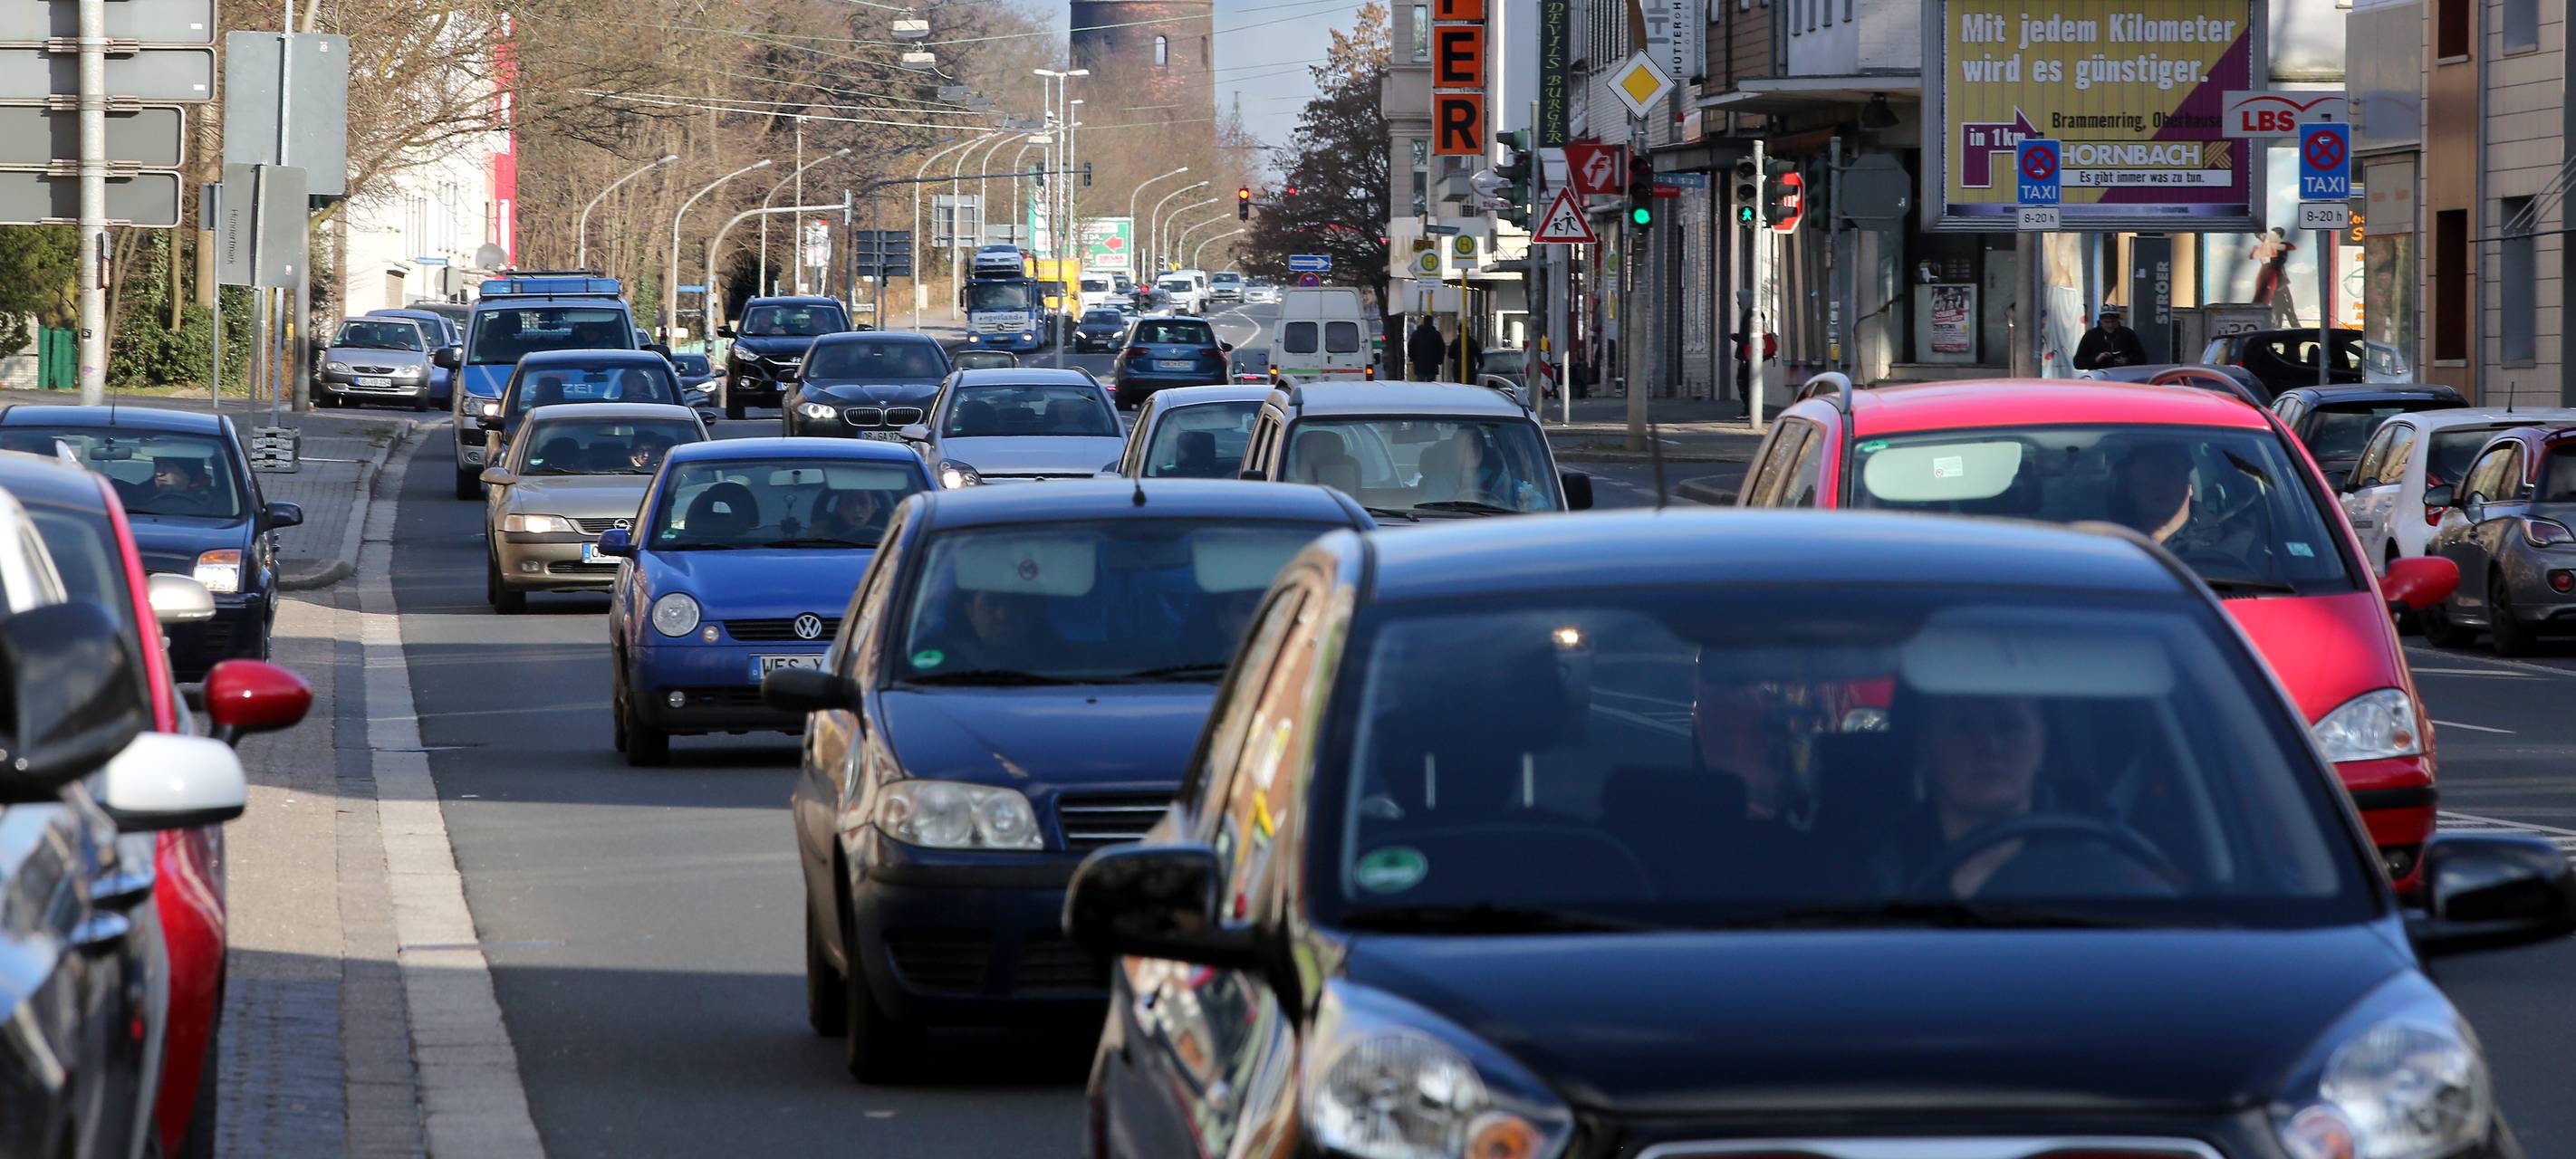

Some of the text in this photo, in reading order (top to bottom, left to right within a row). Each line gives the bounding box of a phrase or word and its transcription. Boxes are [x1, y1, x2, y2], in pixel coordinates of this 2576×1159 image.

[1962, 13, 2236, 49] Mit jedem Kilometer
[1545, 2, 1564, 143] DEVILS BURGER
[1962, 53, 2209, 90] wird es günstiger.
[2052, 112, 2147, 132] Brammenring,
[2242, 110, 2295, 131] LBS
[1969, 128, 1985, 147] in
[2061, 143, 2200, 166] HORNBACH
[2080, 170, 2205, 186] Es gibt immer was zu tun.
[2304, 177, 2345, 193] TAXI
[2021, 185, 2056, 199] TAXI
[2024, 214, 2055, 224] 8-20 h
[2307, 211, 2333, 222] 8-20
[2336, 210, 2342, 221] h
[2154, 261, 2169, 324] STRÖER
